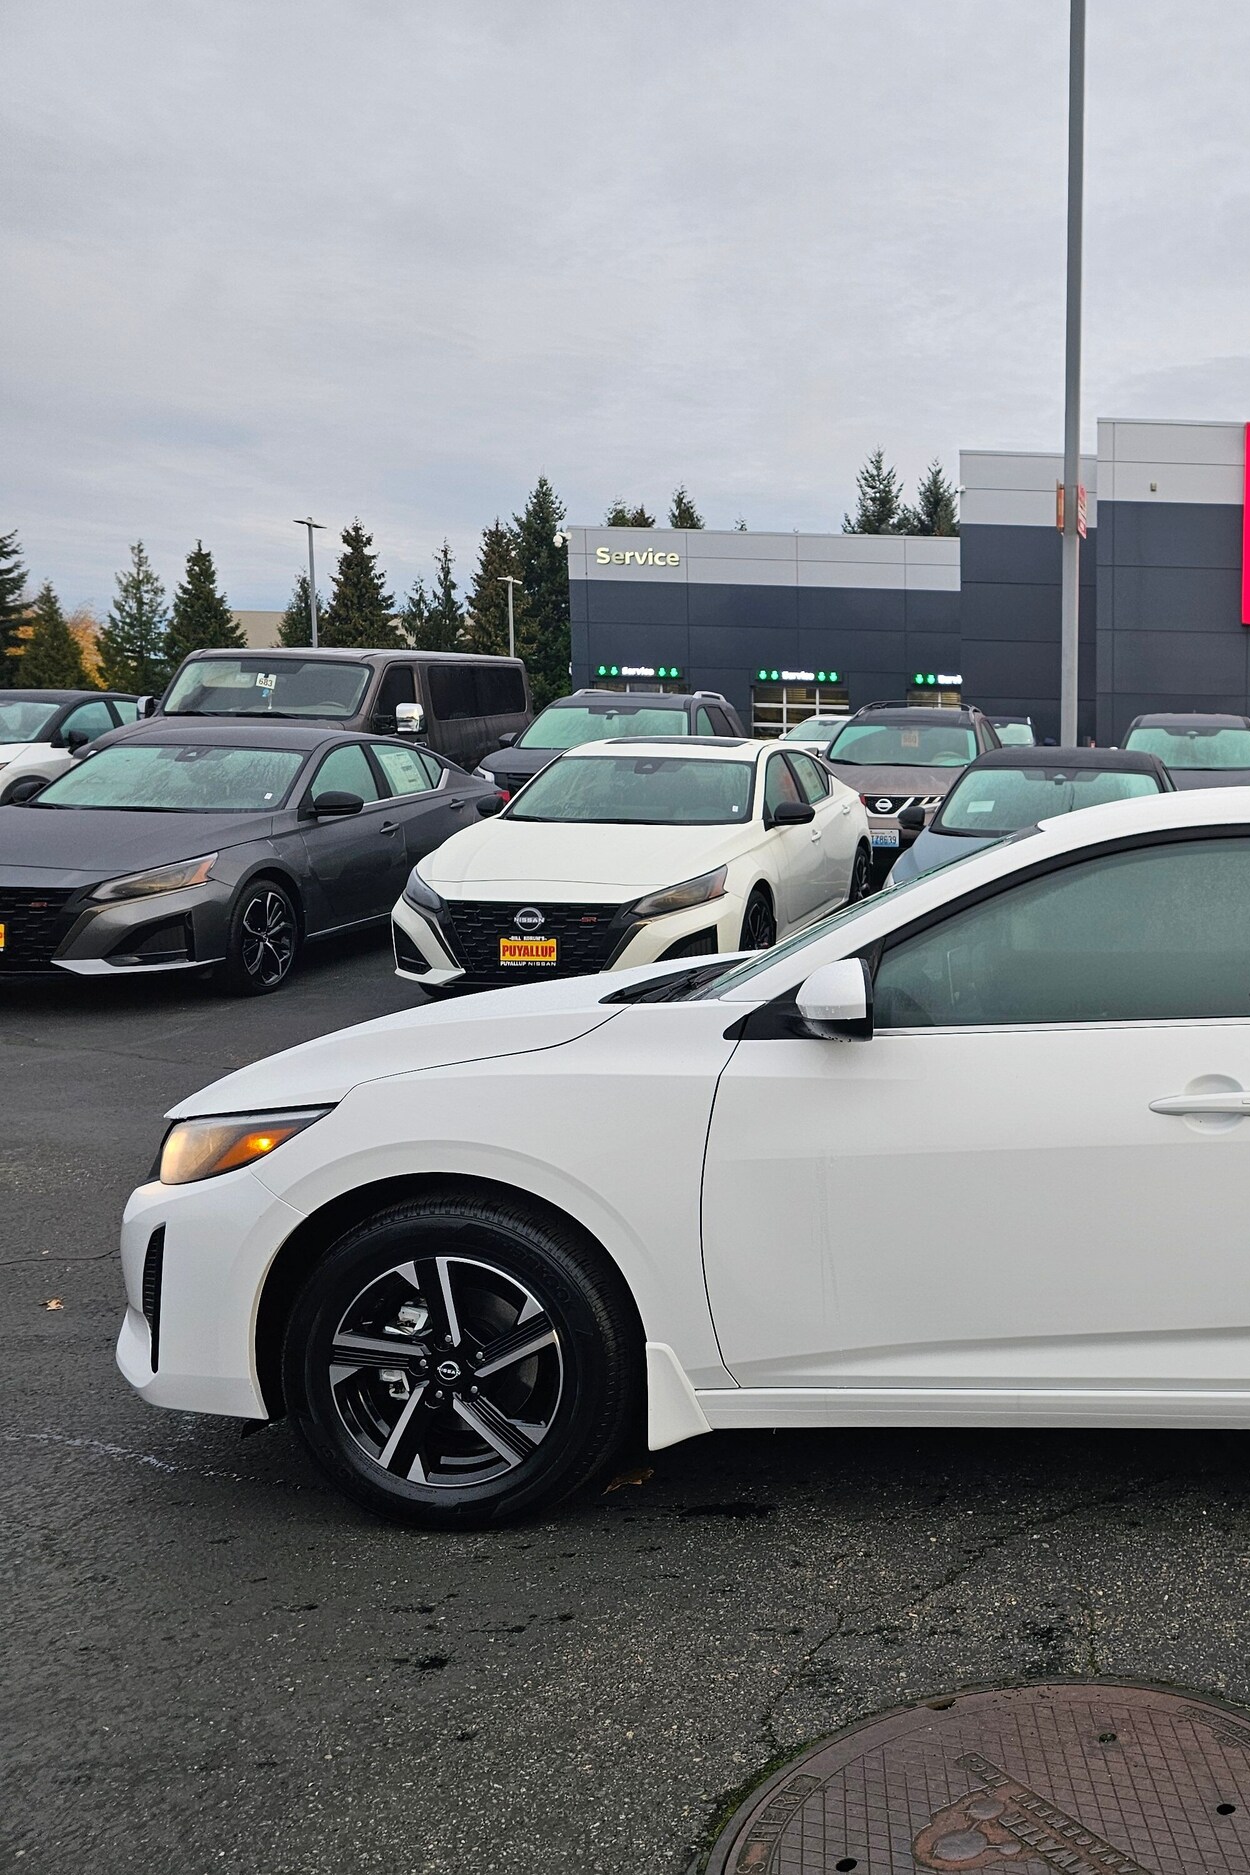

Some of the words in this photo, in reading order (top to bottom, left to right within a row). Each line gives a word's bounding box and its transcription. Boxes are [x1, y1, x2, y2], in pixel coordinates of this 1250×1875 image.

[596, 547, 680, 566] Service
[621, 666, 655, 676] Service
[513, 916, 546, 924] NISSAN
[502, 944, 556, 958] PUYALLUP
[746, 1782, 809, 1842] HERE
